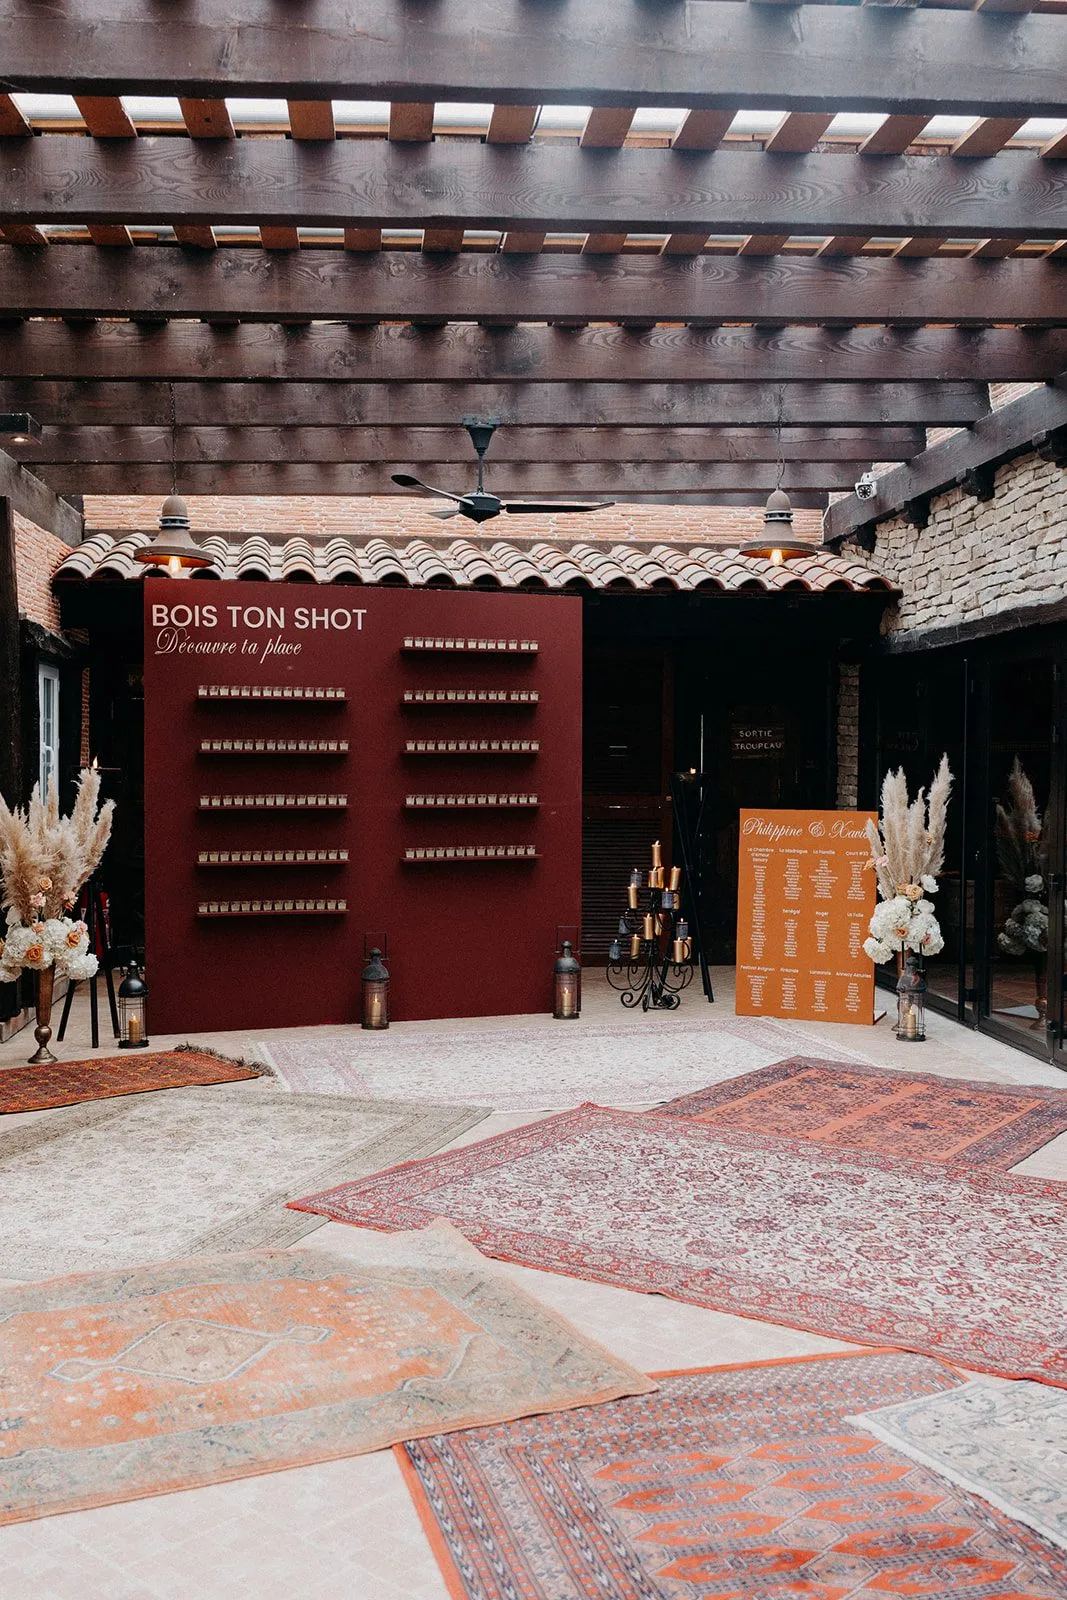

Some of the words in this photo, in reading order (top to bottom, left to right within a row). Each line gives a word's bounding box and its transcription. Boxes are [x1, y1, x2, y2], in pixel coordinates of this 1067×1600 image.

[152, 604, 218, 627] BOIS
[226, 606, 285, 629] TON
[294, 608, 367, 630] SHOT
[154, 626, 237, 655] Découvre
[241, 639, 259, 655] ta
[259, 635, 303, 664] place
[734, 742, 782, 750] TROUPEAU
[739, 730, 773, 738] SORTIE
[742, 817, 803, 842] Philippine
[808, 820, 826, 838] &
